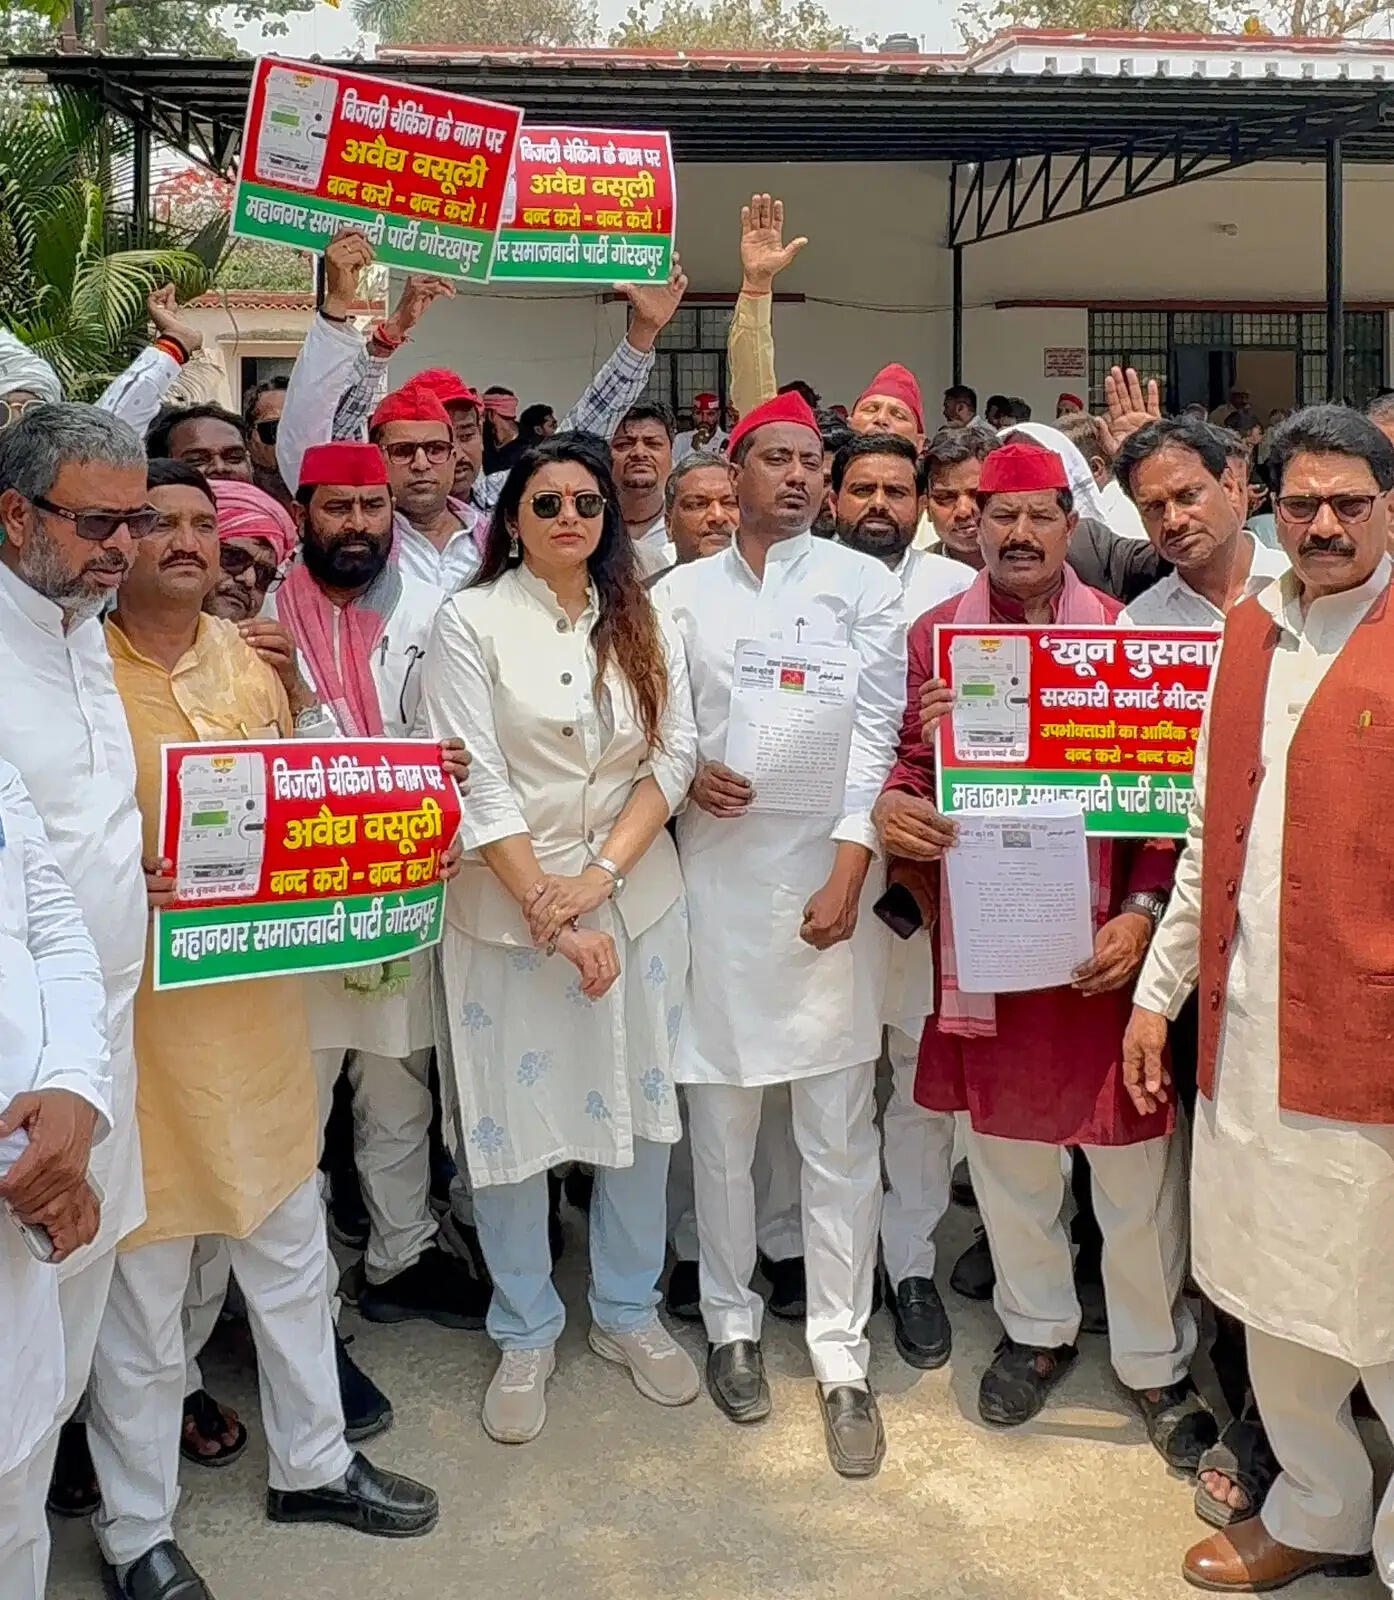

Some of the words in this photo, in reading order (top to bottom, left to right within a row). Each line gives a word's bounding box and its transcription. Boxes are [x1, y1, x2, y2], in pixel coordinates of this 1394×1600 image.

[340, 87, 389, 129] बिजली
[389, 98, 435, 138] चेकिंग
[435, 110, 454, 141] के
[453, 120, 485, 149] नाम
[485, 127, 507, 153] पर
[519, 136, 562, 164] बिजली
[563, 137, 601, 164] चेकिंग
[602, 141, 616, 166] के
[617, 147, 644, 167] नाम
[644, 148, 662, 168] पर
[412, 154, 489, 195] वसूली
[591, 169, 655, 207] वसूली
[327, 175, 357, 200] बन्द
[361, 180, 393, 207] करो
[409, 192, 443, 216] बन्द
[443, 197, 476, 223] करो
[522, 207, 552, 226] बन्द
[553, 203, 581, 227] करो
[595, 209, 624, 228] बन्द
[625, 205, 653, 229] करो
[245, 195, 309, 228] महानगर
[387, 220, 420, 252] पार्टी
[420, 226, 484, 274] गोरखपुर
[511, 234, 580, 264] समाजवादी
[582, 234, 610, 265] पार्टी
[610, 237, 665, 276] गोरखपुर
[1040, 680, 1110, 708] सरकारी
[1113, 681, 1161, 710] स्मार्ट
[1118, 724, 1138, 740] का
[1140, 720, 1187, 741] आर्थिक
[1064, 748, 1092, 764] बन्द
[1095, 744, 1121, 764] करो
[1136, 749, 1165, 764] बन्द
[1166, 746, 1194, 765] करो
[272, 757, 326, 800] बिजली
[327, 755, 375, 796] चेकिंग
[376, 756, 393, 793] के
[392, 764, 424, 792] नाम
[423, 764, 446, 791] पर
[1116, 774, 1151, 813] पार्टी
[363, 797, 443, 855] वसूली
[270, 869, 309, 895] बन्द
[312, 856, 349, 892] करो
[368, 861, 404, 887] बन्द
[406, 848, 435, 882] करो
[170, 921, 250, 960] महानगर
[252, 901, 347, 951] समाजवादी
[349, 896, 383, 941] पार्टी
[385, 896, 438, 941] गोरखपुर
